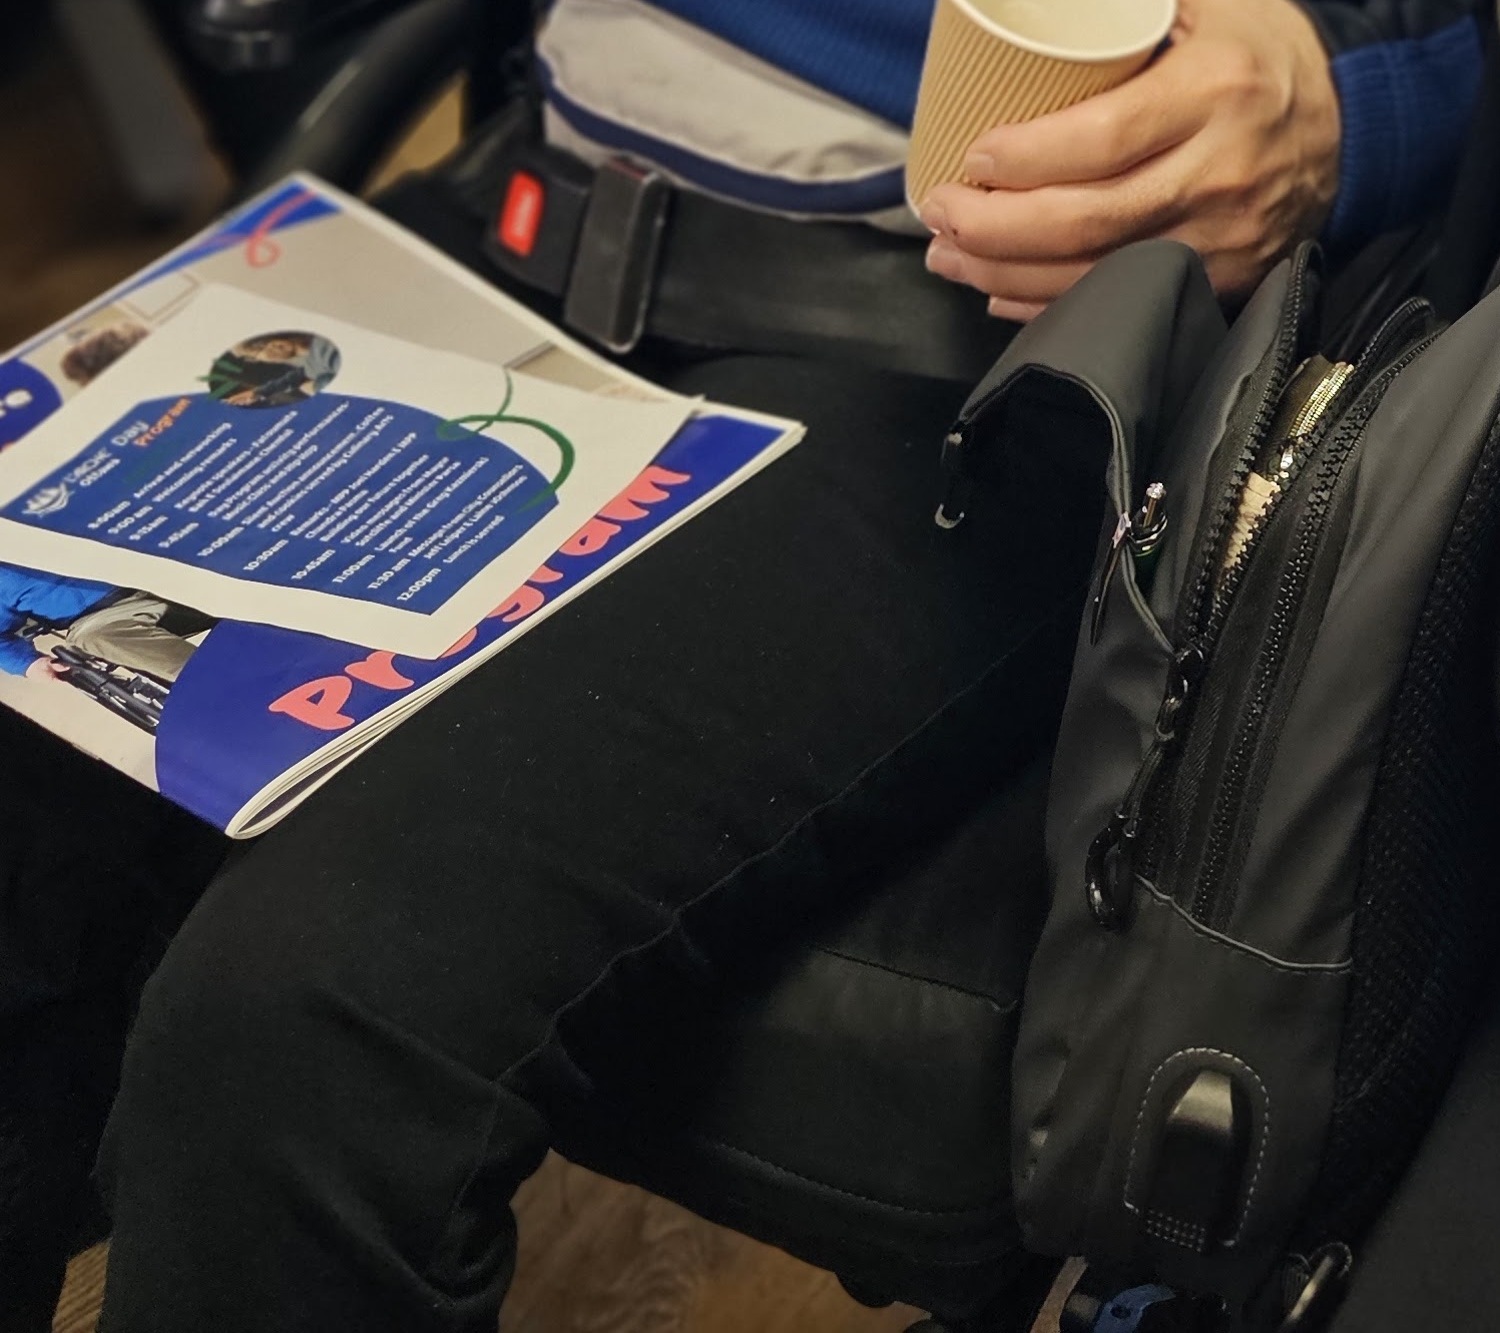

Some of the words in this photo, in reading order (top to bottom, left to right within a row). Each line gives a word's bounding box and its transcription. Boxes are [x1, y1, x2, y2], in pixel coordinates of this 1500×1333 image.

[111, 421, 150, 446] Day
[133, 396, 192, 448] Program
[80, 458, 122, 487] Ottawa
[134, 475, 167, 498] Arrival
[163, 462, 183, 476] and
[180, 423, 232, 462] networking
[153, 466, 204, 502] Welcoming
[200, 438, 237, 467] remarks
[258, 514, 278, 528] and
[305, 466, 336, 490] served
[374, 415, 393, 431] Arts
[320, 513, 358, 542] Building
[355, 502, 370, 515] our
[367, 482, 396, 502] future
[393, 455, 428, 482] together
[341, 525, 368, 543] Video
[402, 476, 428, 494] from
[390, 505, 408, 520] and
[108, 516, 139, 534] 9:00
[134, 506, 153, 518] am
[129, 516, 168, 540] 9:15am
[241, 506, 269, 525] Silent
[272, 514, 295, 532] crew
[290, 507, 329, 536] Remarks
[305, 510, 343, 538] Chandra
[375, 528, 407, 551] Launch
[404, 519, 416, 529] of
[412, 508, 430, 520] the
[427, 491, 450, 508] Greg
[408, 527, 449, 557] Message
[442, 513, 467, 529] from
[462, 499, 483, 514] City
[198, 527, 244, 556] 10:00am
[389, 537, 412, 552] Fund
[424, 545, 442, 559] Jeff
[443, 543, 472, 563] Lunch
[475, 516, 504, 539] served
[243, 540, 288, 570] 10:30am
[292, 549, 335, 579] 10:45am
[332, 555, 375, 583] 11:00am
[368, 571, 394, 589] 11:30
[392, 558, 411, 571] am
[397, 568, 441, 601] 12:00pm
